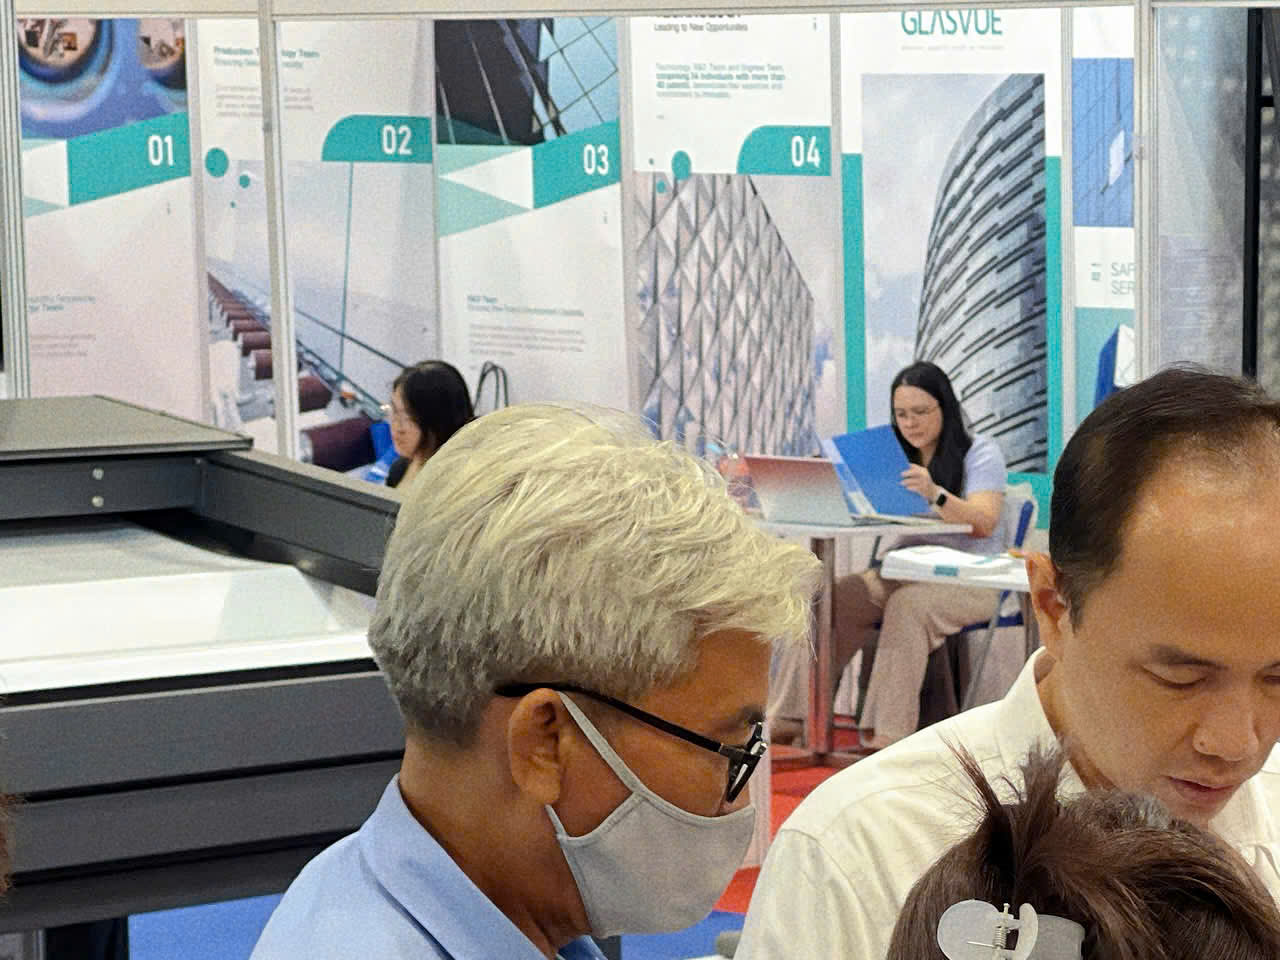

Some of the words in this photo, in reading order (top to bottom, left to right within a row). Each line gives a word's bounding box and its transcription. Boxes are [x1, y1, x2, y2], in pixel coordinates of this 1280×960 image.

[147, 135, 174, 166] 01
[382, 125, 412, 155] 02
[791, 135, 821, 167] 04
[583, 143, 609, 176] 03
